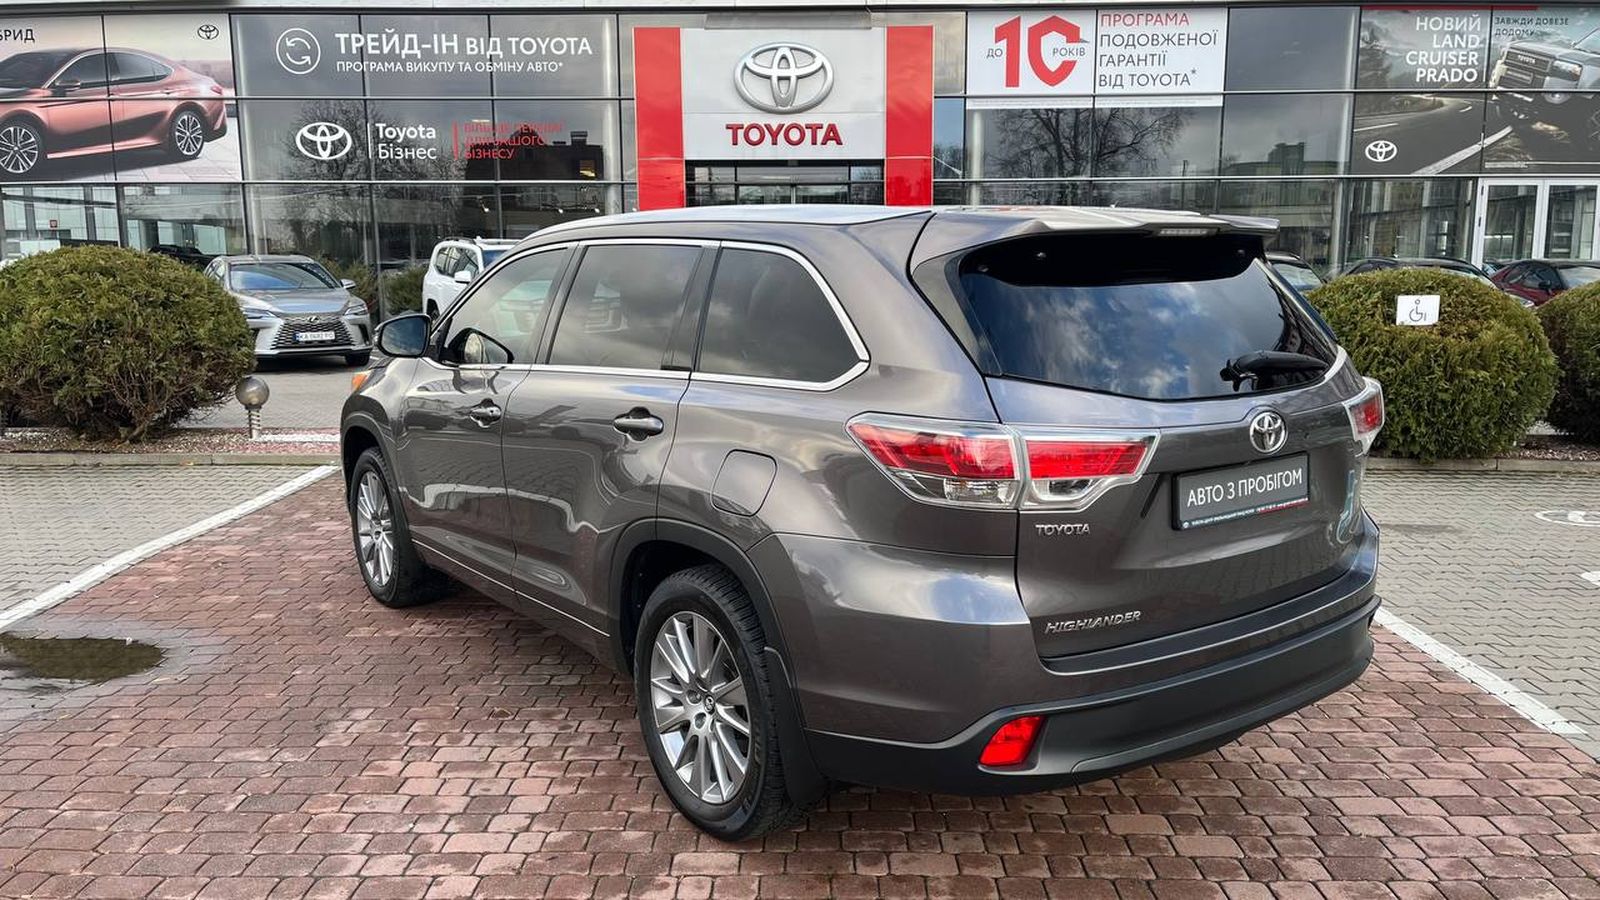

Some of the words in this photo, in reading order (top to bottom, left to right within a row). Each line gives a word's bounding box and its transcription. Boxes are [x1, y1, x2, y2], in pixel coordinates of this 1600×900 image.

[1100, 13, 1190, 27] ПРОГРАМА
[1416, 14, 1481, 32] НОВИЙ
[1494, 17, 1533, 25] ЗАВЖДИ
[1535, 17, 1569, 25] ДОВЕЗЕ
[334, 28, 458, 59] ТРЕЙД-ІН
[465, 37, 503, 59] ВІД
[507, 37, 593, 55] TOYOTA
[1100, 29, 1219, 49] ПОДОВЖЕНОЇ
[1433, 34, 1480, 48] LAND
[986, 48, 1003, 58] ДО
[1052, 47, 1086, 57] РОКІВ
[1099, 50, 1168, 67] ГАРАНТІЇ
[1406, 51, 1479, 65] CRUISER
[336, 61, 404, 72] ПРОГРАМА
[406, 61, 455, 72] ВИКУПУ
[458, 61, 473, 72] ТА
[474, 61, 524, 72] ОБМІНУ
[1098, 74, 1124, 89] ВІД
[1416, 68, 1478, 82] PRADO
[375, 123, 436, 142] Toyota
[726, 123, 843, 146] TOYOTA
[378, 143, 437, 160] Бізнес
[1187, 484, 1225, 508] АВТО
[1238, 468, 1303, 498] ПРОБІГОМ
[1035, 523, 1091, 535] TOYOTA
[1044, 610, 1142, 634] HIGHLANDER
